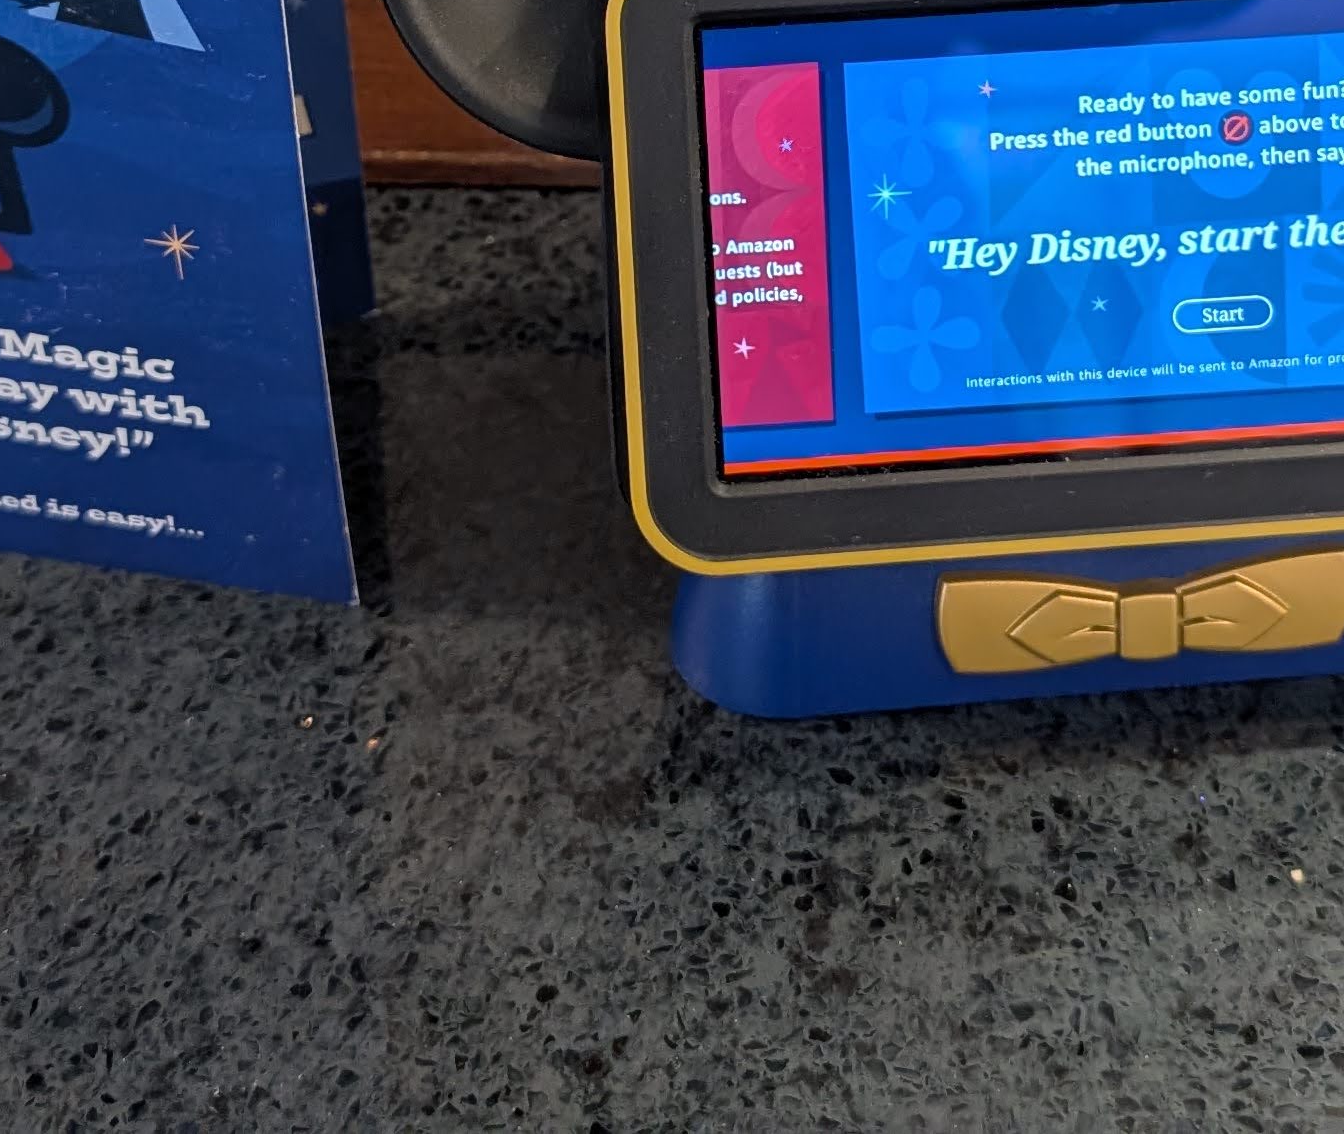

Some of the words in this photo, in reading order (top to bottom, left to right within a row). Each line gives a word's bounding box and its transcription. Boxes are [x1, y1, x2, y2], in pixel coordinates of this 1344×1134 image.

[1078, 93, 1144, 115] Ready
[1152, 92, 1175, 109] to
[1181, 88, 1232, 108] have
[1238, 86, 1296, 104] some
[990, 132, 1047, 151] Press
[1053, 128, 1089, 147] the
[1096, 124, 1132, 144] red
[1138, 121, 1212, 142] button
[1259, 114, 1323, 134] above
[1076, 157, 1112, 177] the
[1118, 149, 1255, 175] microphone,
[1261, 145, 1311, 166] then
[726, 238, 795, 254] Amazon
[927, 237, 1017, 277] "Hey
[1026, 230, 1168, 266] Disney,
[1176, 220, 1278, 255] start
[766, 261, 803, 279] (but
[732, 287, 803, 307] policies,
[1201, 304, 1244, 324] Start
[965, 372, 1043, 389] Interactions
[1046, 370, 1074, 383] with
[1078, 367, 1103, 381] this
[1107, 365, 1148, 380] device
[1151, 364, 1174, 377] will
[1178, 362, 1195, 376] be
[1199, 360, 1226, 374] sent
[1230, 359, 1245, 371] to
[1248, 355, 1301, 371] Amazon
[1304, 353, 1323, 367] for
[69, 387, 210, 429] with
[46, 497, 80, 523] is
